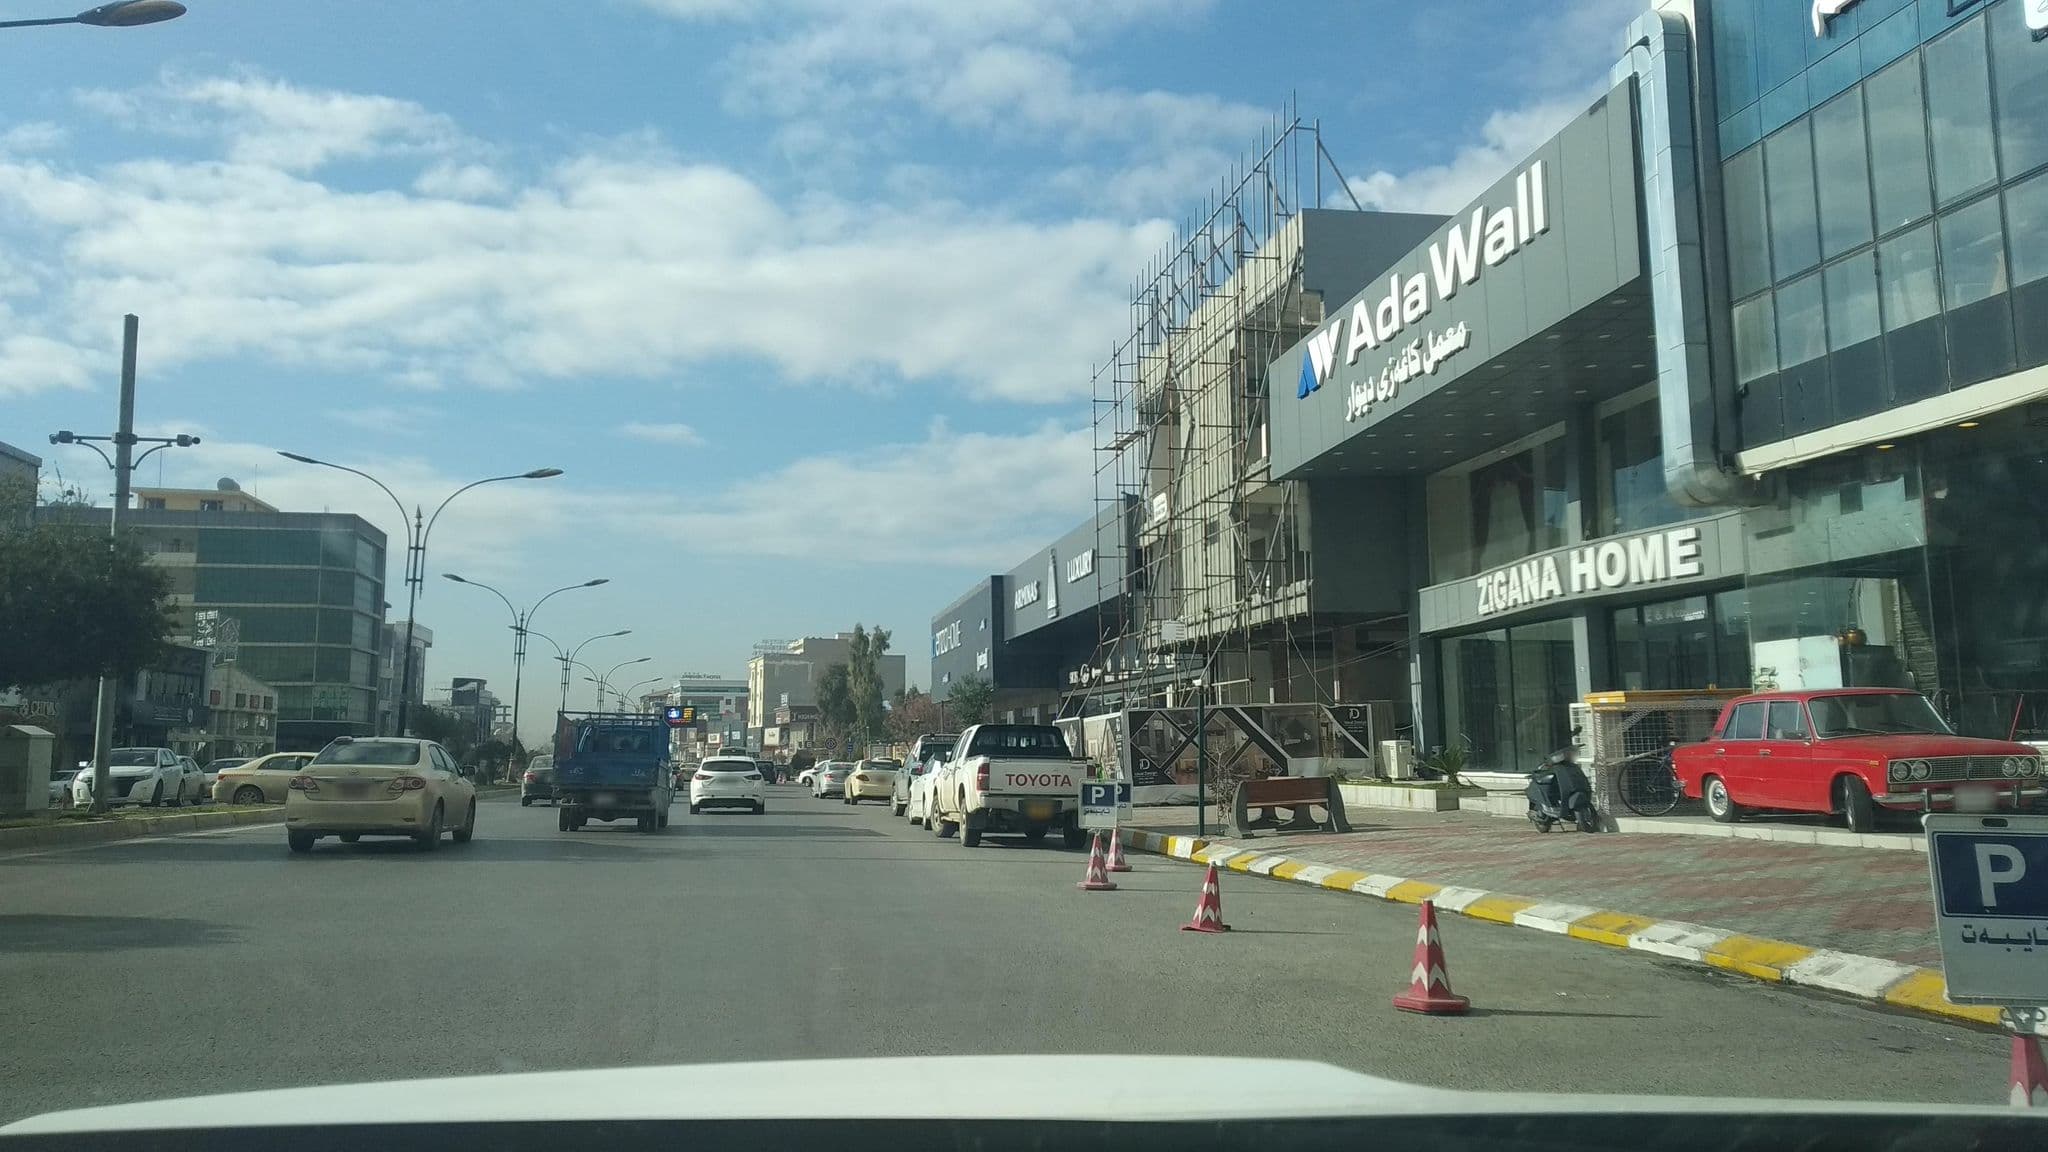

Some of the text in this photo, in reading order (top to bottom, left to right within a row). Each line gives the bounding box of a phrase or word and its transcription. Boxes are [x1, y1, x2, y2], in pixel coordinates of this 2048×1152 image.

[1067, 549, 1093, 583] LUXURY
[1570, 528, 1701, 593] HOME
[1006, 773, 1072, 787] TOYOTA
[1091, 786, 1105, 804] P
[1975, 843, 2026, 907] P
